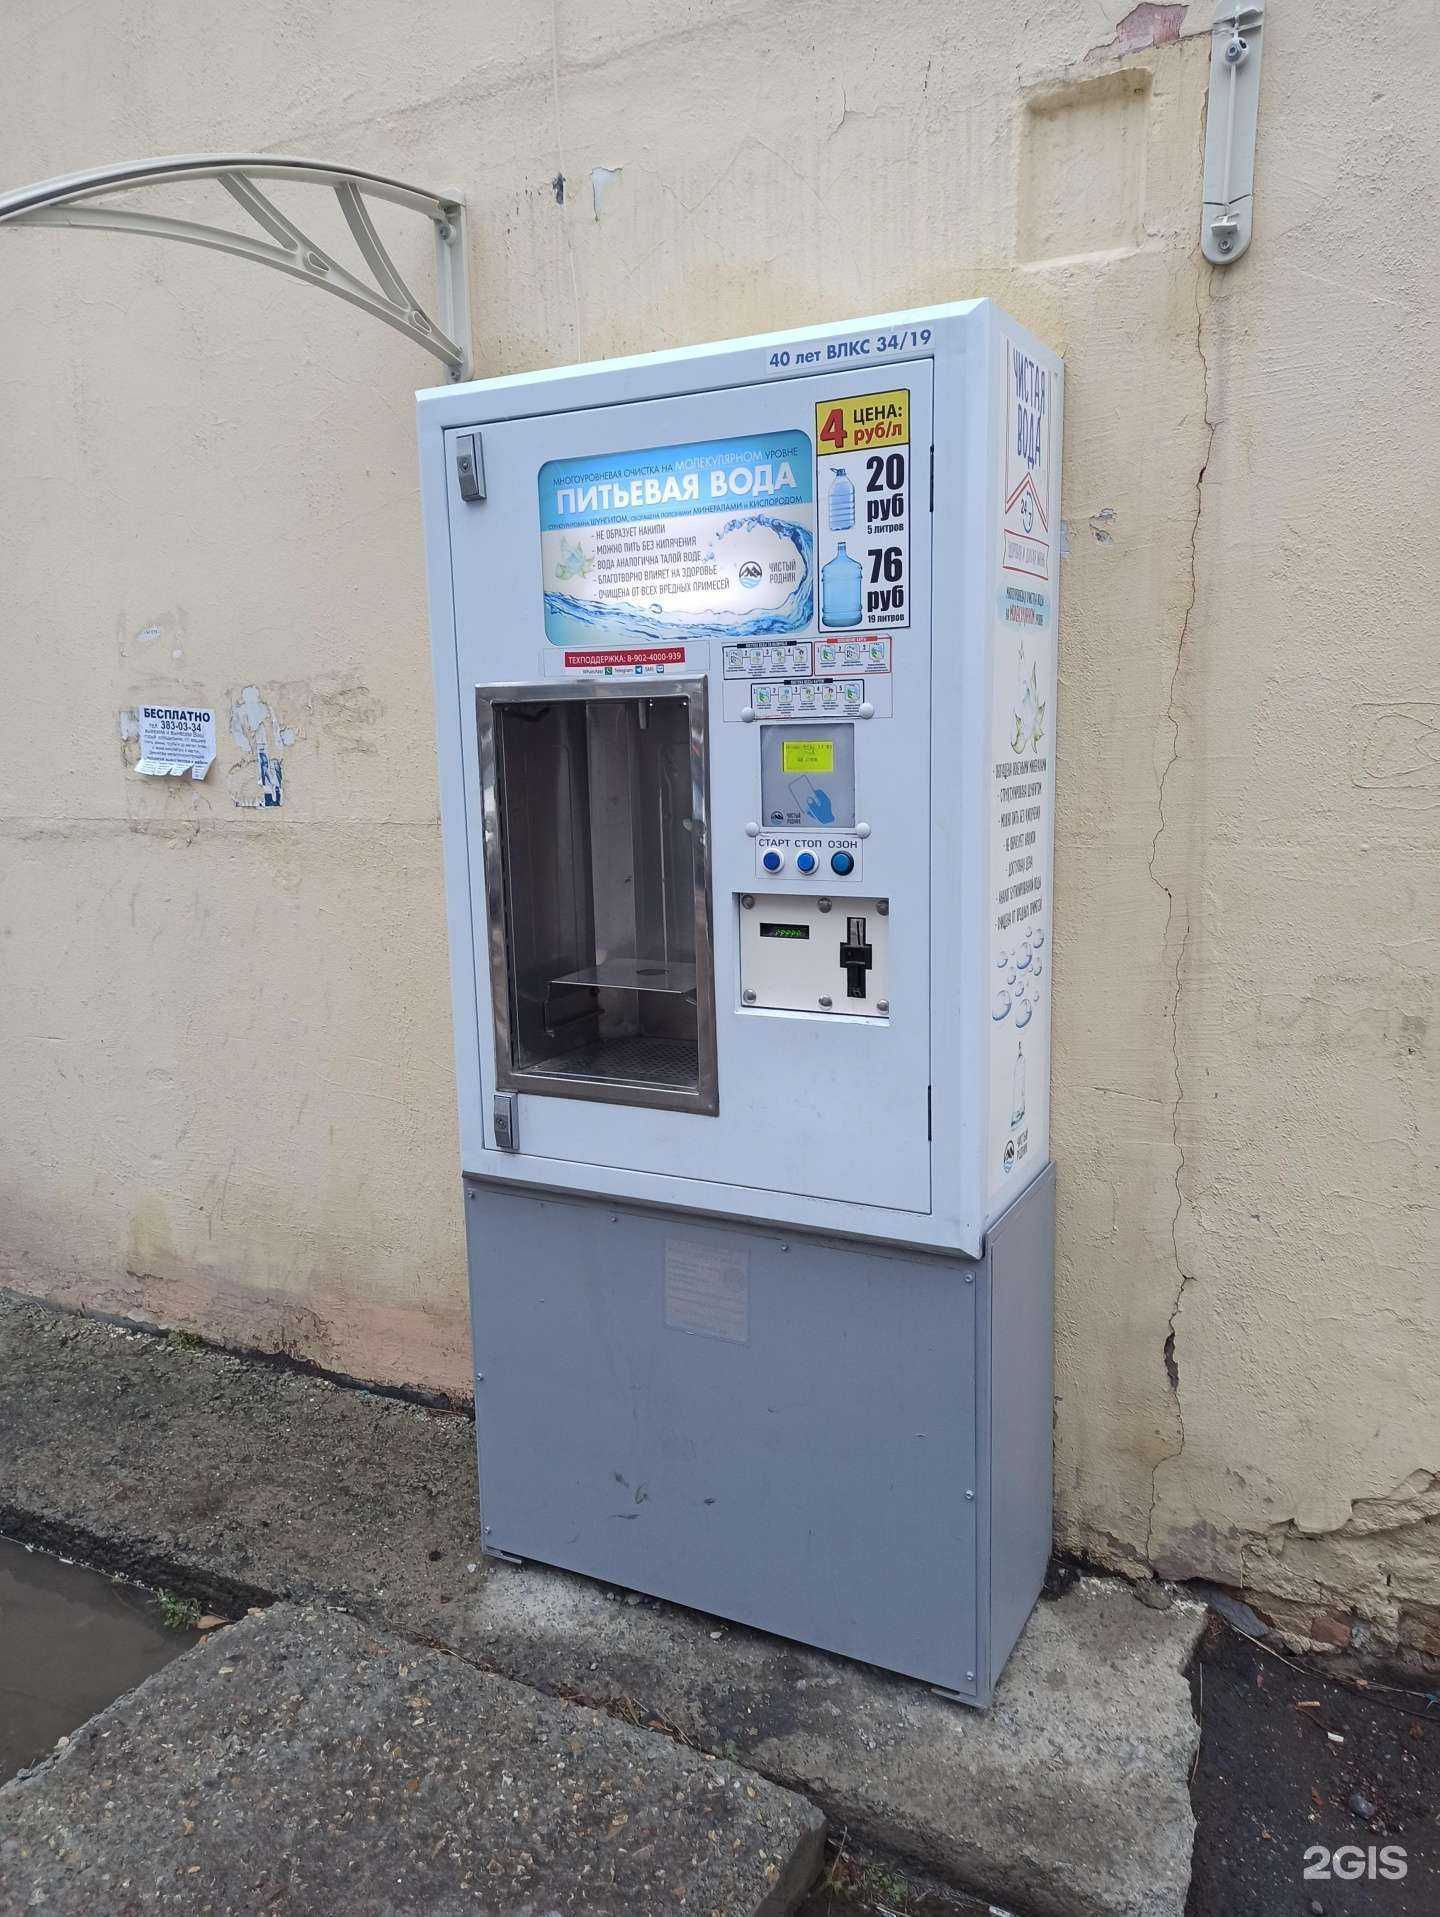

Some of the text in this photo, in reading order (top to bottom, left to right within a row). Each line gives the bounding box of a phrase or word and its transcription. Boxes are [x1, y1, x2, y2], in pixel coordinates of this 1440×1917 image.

[769, 329, 931, 367] 40 лет ВЛКС 34/19
[1013, 347, 1045, 415] ЧИСТАЯ
[853, 404, 902, 425] ЦЕНА:
[820, 408, 848, 449] 4
[854, 421, 902, 445] руб/л
[1017, 403, 1041, 470] ВОДА
[553, 446, 799, 486] МНОГОУРОВНЕВАЯ ОЧИСТКА НА МОЛЕКУЛЯРНОМ УРОВНЕ
[866, 453, 905, 493] 20
[556, 461, 797, 515] ПИТЬЕВАЯ ВОДА
[749, 495, 803, 508] КИСЛОРОДОМ
[867, 492, 904, 523] руб
[596, 524, 665, 540] НЕ ОБРАЗУЕТ НАКИПИ
[867, 522, 904, 535] 5 литров
[596, 536, 697, 555] МОЖНО ПИТЬ БЕЗ КИПЯЧЕНИЯ
[597, 559, 614, 571] ВОДА
[617, 555, 659, 568] АНАЛОГИЧНА
[661, 551, 681, 564] ТАЛОЙ
[769, 558, 797, 573] ЧИСТЫЙ
[867, 546, 903, 583] 76
[598, 564, 718, 585] БЛАГОТВОРНО ВЛИЯЕТ НА ЗДОРОВЬЕ
[769, 571, 796, 584] РОДНИК
[598, 577, 730, 600] ОЧИЩЕНА ОТ ВСЕХ ВРЕДНЫХ ПРИМЕСЕЙ
[867, 585, 904, 613] руб
[867, 613, 905, 624] 19 литров
[568, 652, 682, 665] ТЕХПОДДЕРЖКА: 8-902-4000-939
[144, 708, 210, 723] БЕСПЛАТНО
[160, 720, 201, 732] 383-03-34
[758, 839, 858, 849] СТАРТ СТОП ОЗОН
